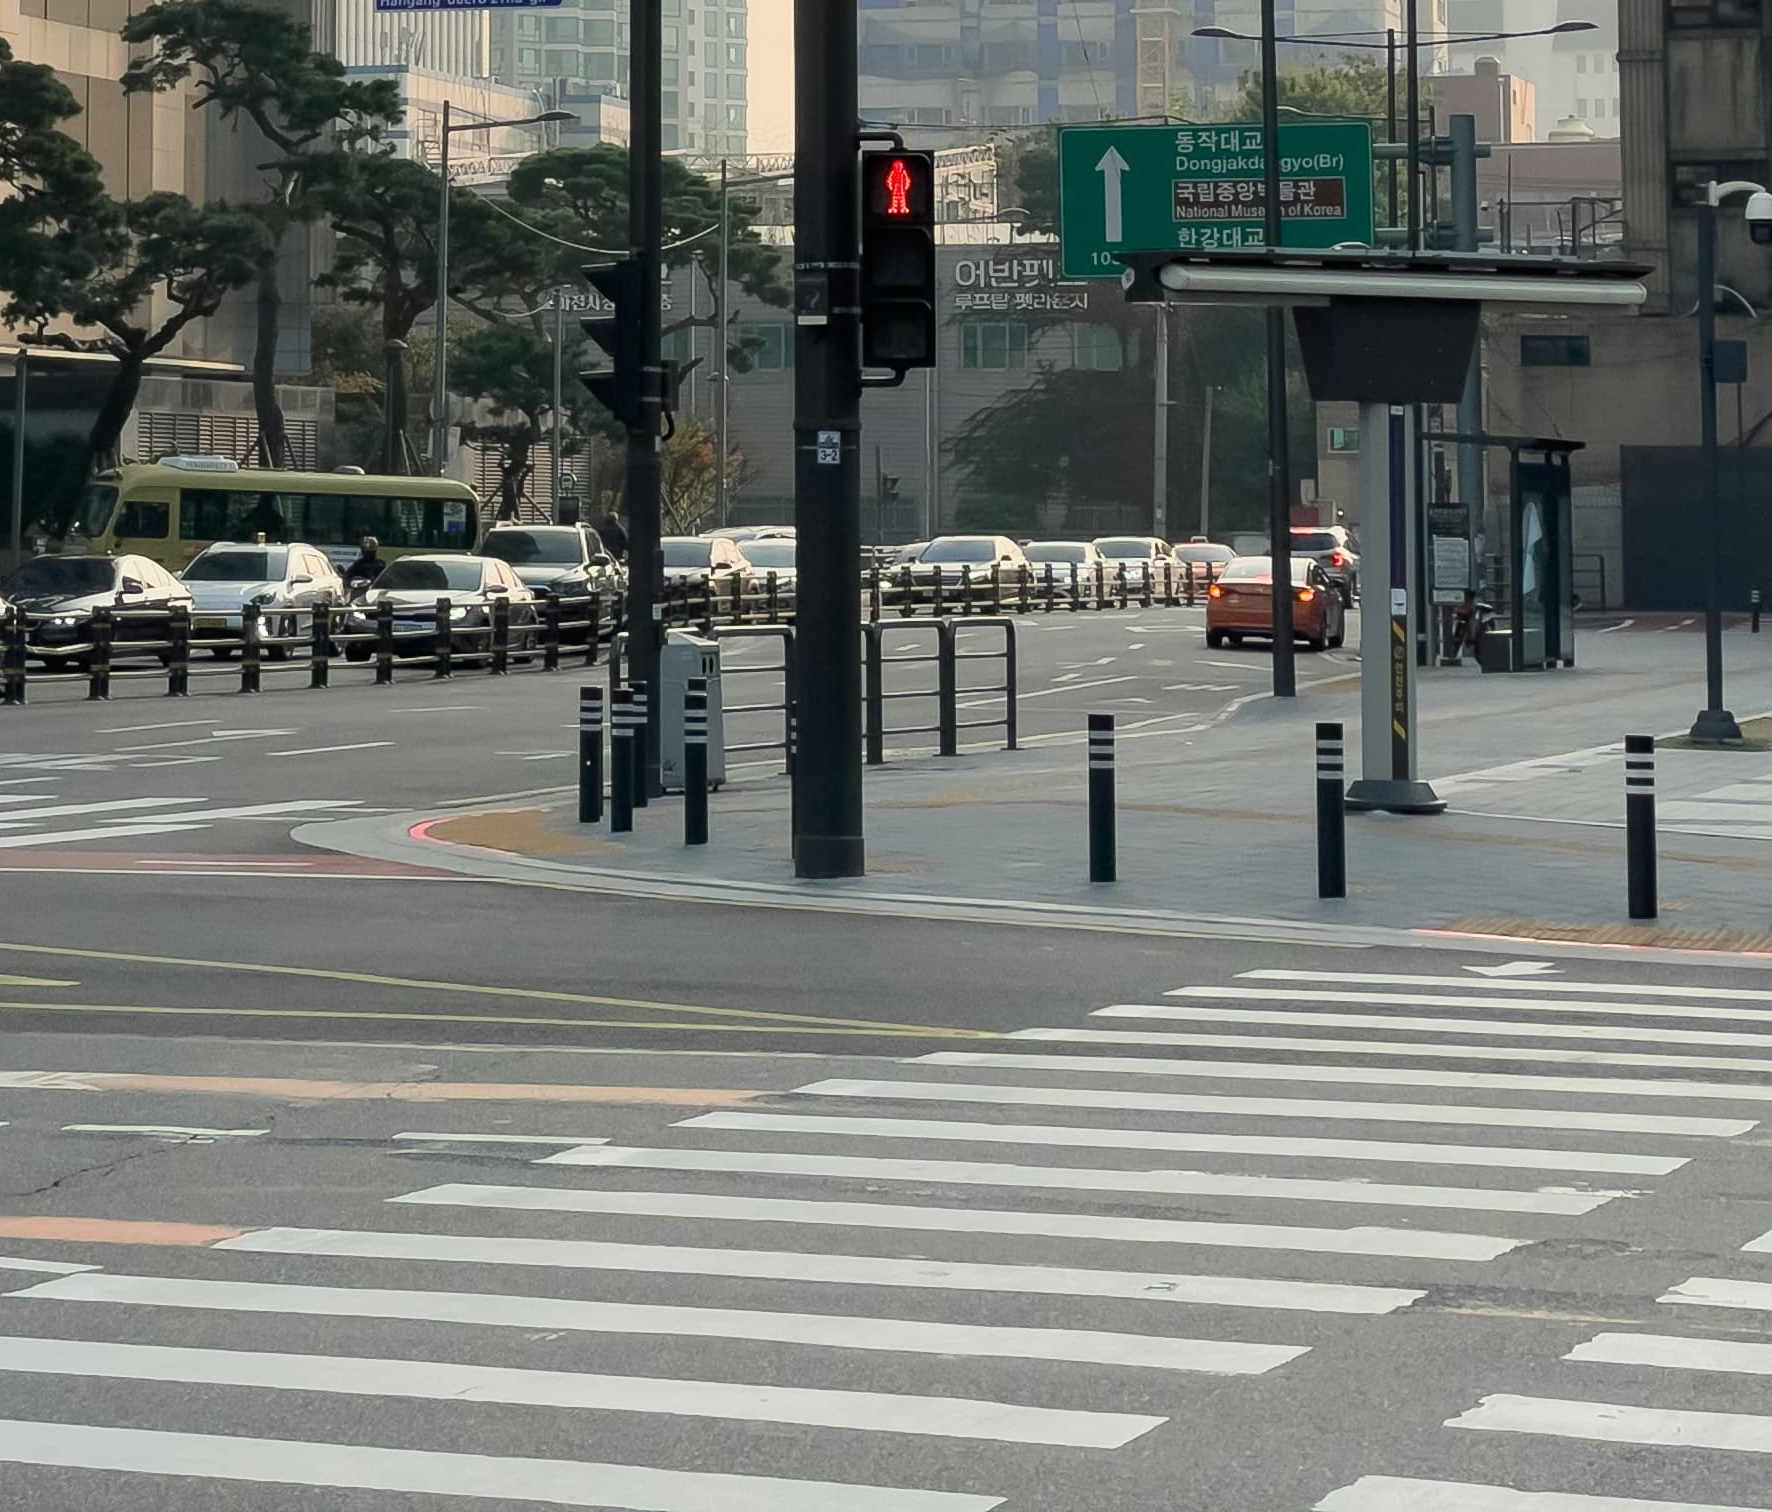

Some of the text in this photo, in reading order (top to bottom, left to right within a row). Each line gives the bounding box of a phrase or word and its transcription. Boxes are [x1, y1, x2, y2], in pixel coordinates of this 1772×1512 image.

[1175, 130, 1264, 153] 동작대교
[1176, 153, 1344, 173] Dongjakdgyo(Br)
[1176, 203, 1342, 219] National Muse of Korea
[1178, 226, 1266, 249] 한강대교
[955, 259, 1088, 288] 어반펫
[820, 449, 838, 462] 3-2
